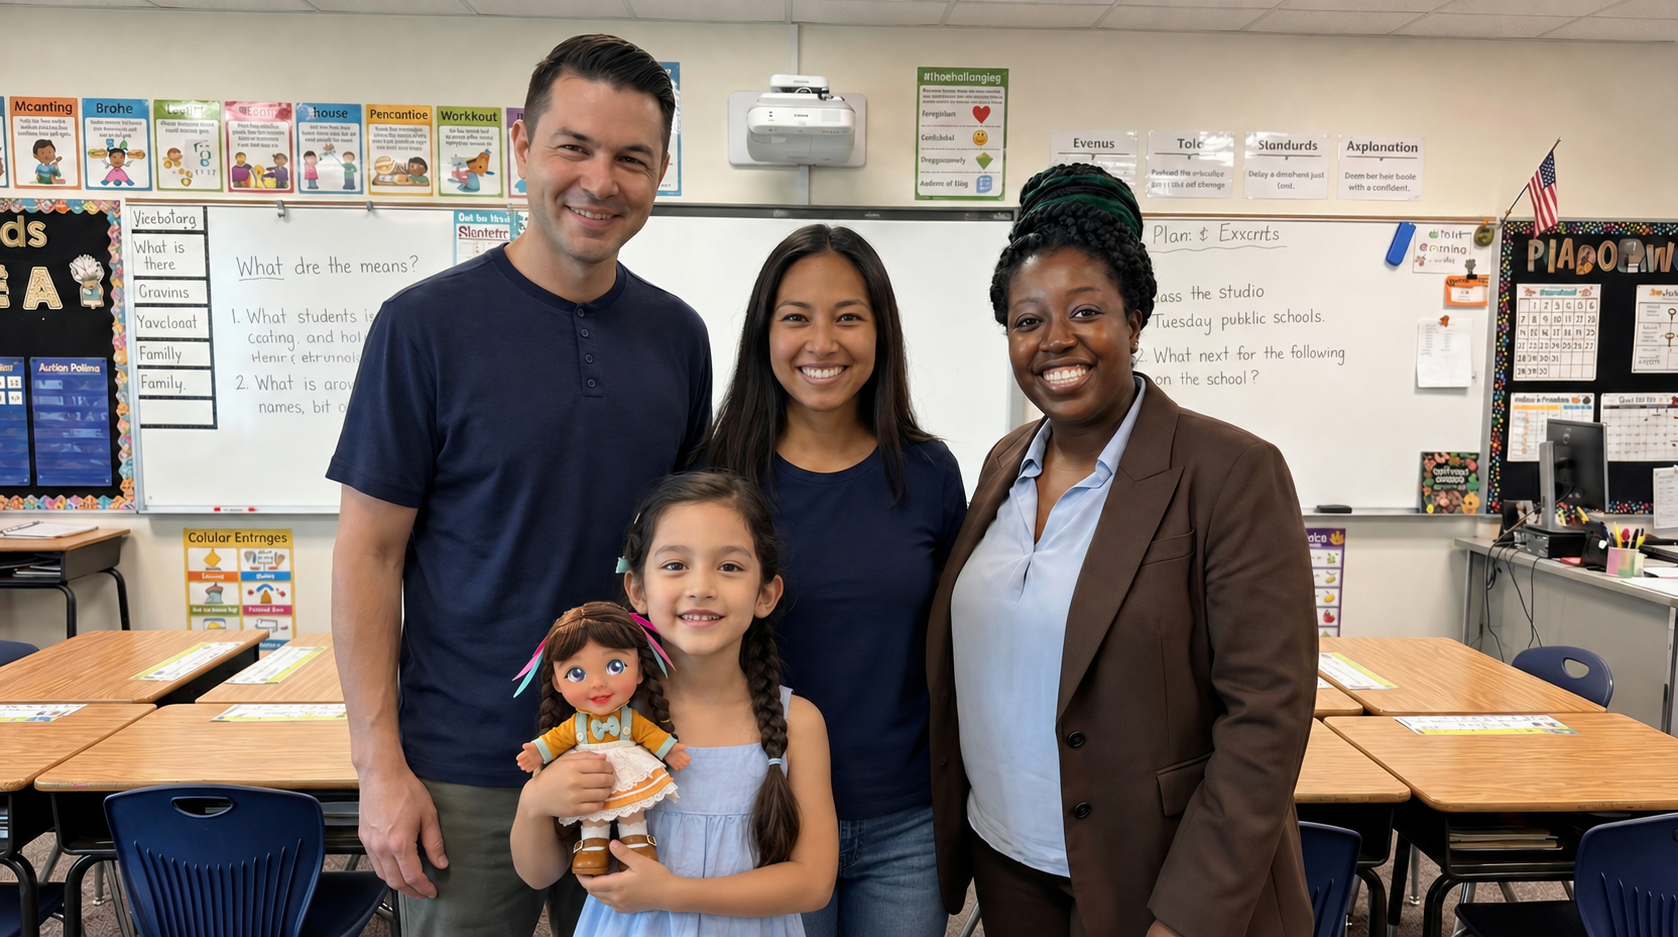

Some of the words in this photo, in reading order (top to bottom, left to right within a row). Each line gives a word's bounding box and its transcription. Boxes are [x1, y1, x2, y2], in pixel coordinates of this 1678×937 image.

[96, 102, 133, 114] Brohe
[441, 110, 498, 122] Workkout
[1073, 137, 1115, 149] Evenus
[1, 215, 48, 248] ds
[1153, 225, 1192, 244] Plan:
[134, 241, 167, 254] What
[174, 241, 185, 254] is
[144, 256, 176, 271] there
[236, 255, 283, 278] What
[328, 255, 352, 274] the
[360, 254, 419, 274] means?
[1190, 285, 1212, 301] the
[1219, 283, 1265, 299] studio
[246, 307, 286, 324] What
[297, 307, 357, 324] students
[1152, 313, 1213, 336] Tuesday
[1273, 308, 1326, 325] schools.
[306, 330, 334, 344] and
[139, 345, 183, 364] Familly
[1153, 346, 1192, 364] What
[1199, 345, 1229, 362] next
[1236, 344, 1256, 361] for
[1263, 345, 1285, 360] the
[1290, 344, 1346, 366] following
[255, 373, 294, 391] What
[304, 376, 317, 391] is
[1155, 373, 1172, 386] on
[1180, 371, 1200, 386] the
[1206, 370, 1247, 386] school
[258, 402, 305, 416] names,
[312, 399, 331, 414] bit
